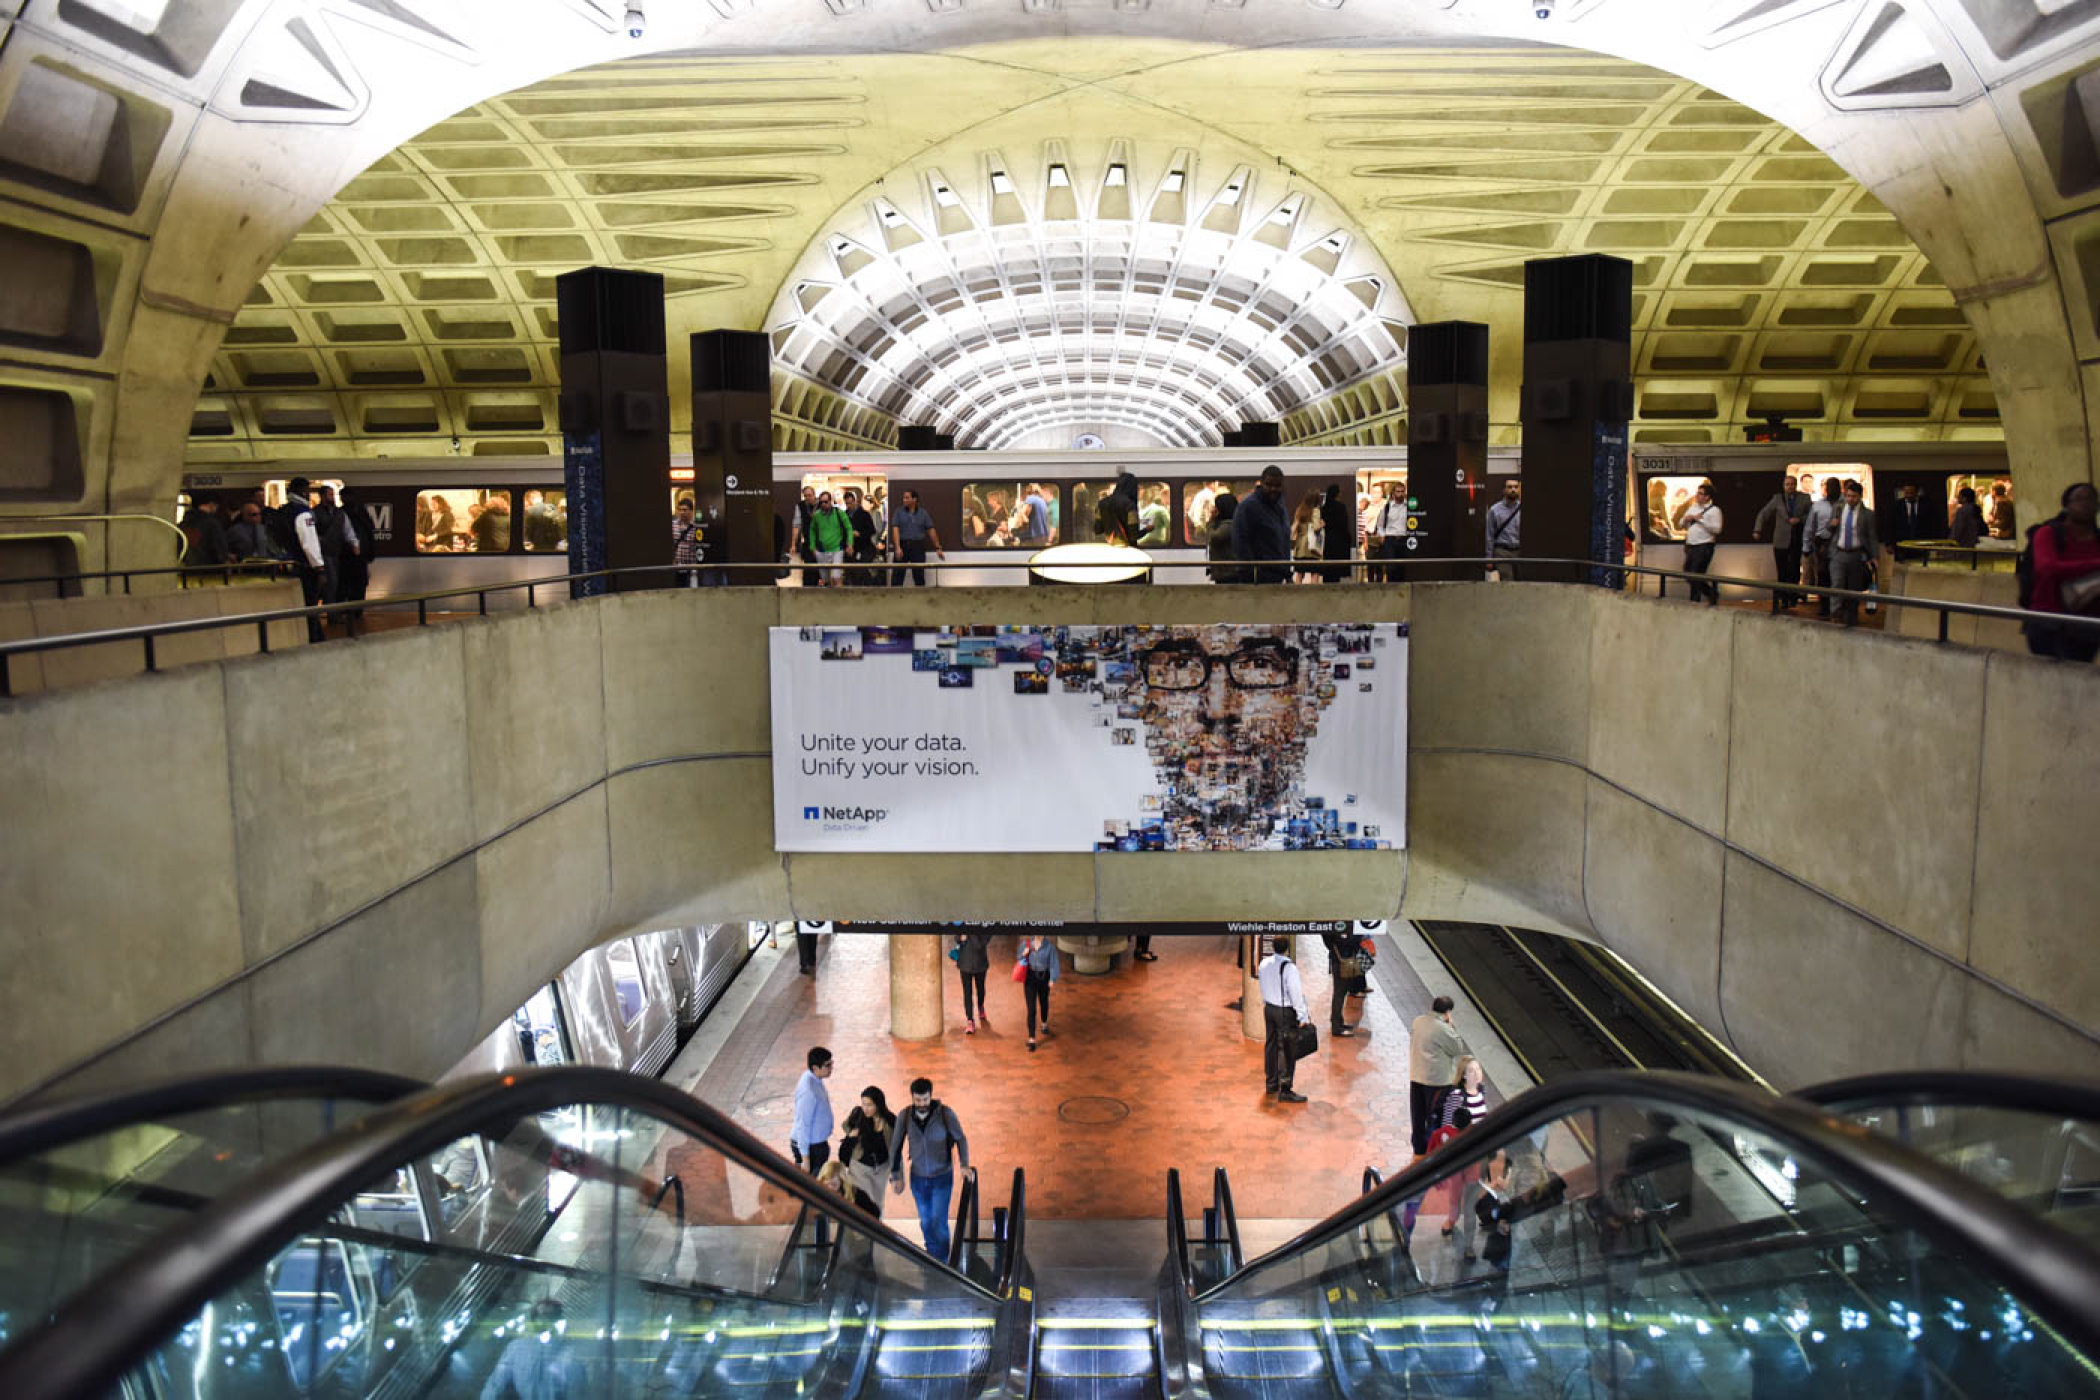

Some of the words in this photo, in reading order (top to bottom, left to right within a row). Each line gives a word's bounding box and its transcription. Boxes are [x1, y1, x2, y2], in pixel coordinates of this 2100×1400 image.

[1607, 455, 1615, 489] Data
[1643, 458, 1669, 469] 3031
[578, 466, 586, 499] Data
[801, 733, 856, 751] Unite
[862, 737, 909, 754] your
[915, 733, 967, 751] data.
[801, 758, 856, 779] Unify
[862, 761, 909, 779] your
[915, 758, 979, 776] vision.
[823, 807, 887, 822] NetApp
[1227, 922, 1305, 931] Wiehle-Reston
[1309, 922, 1332, 931] East
